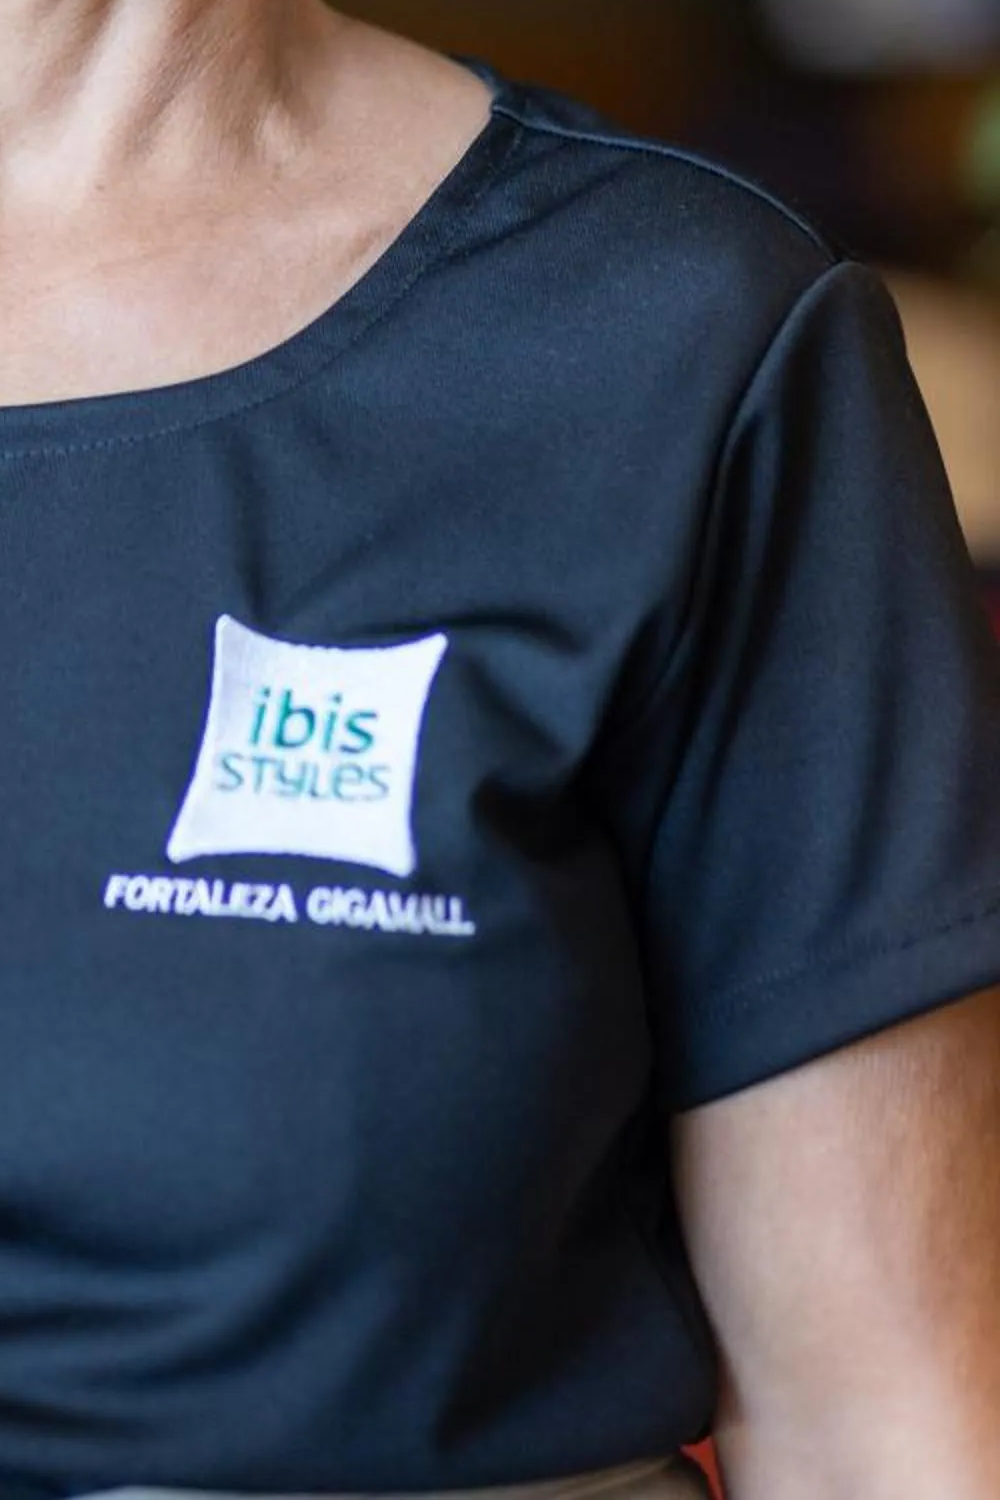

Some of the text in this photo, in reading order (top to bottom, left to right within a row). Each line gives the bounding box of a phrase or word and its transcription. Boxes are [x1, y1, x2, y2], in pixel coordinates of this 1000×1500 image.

[250, 686, 378, 754] ibis
[104, 874, 476, 936] FORTALEZA GIGAMALL
